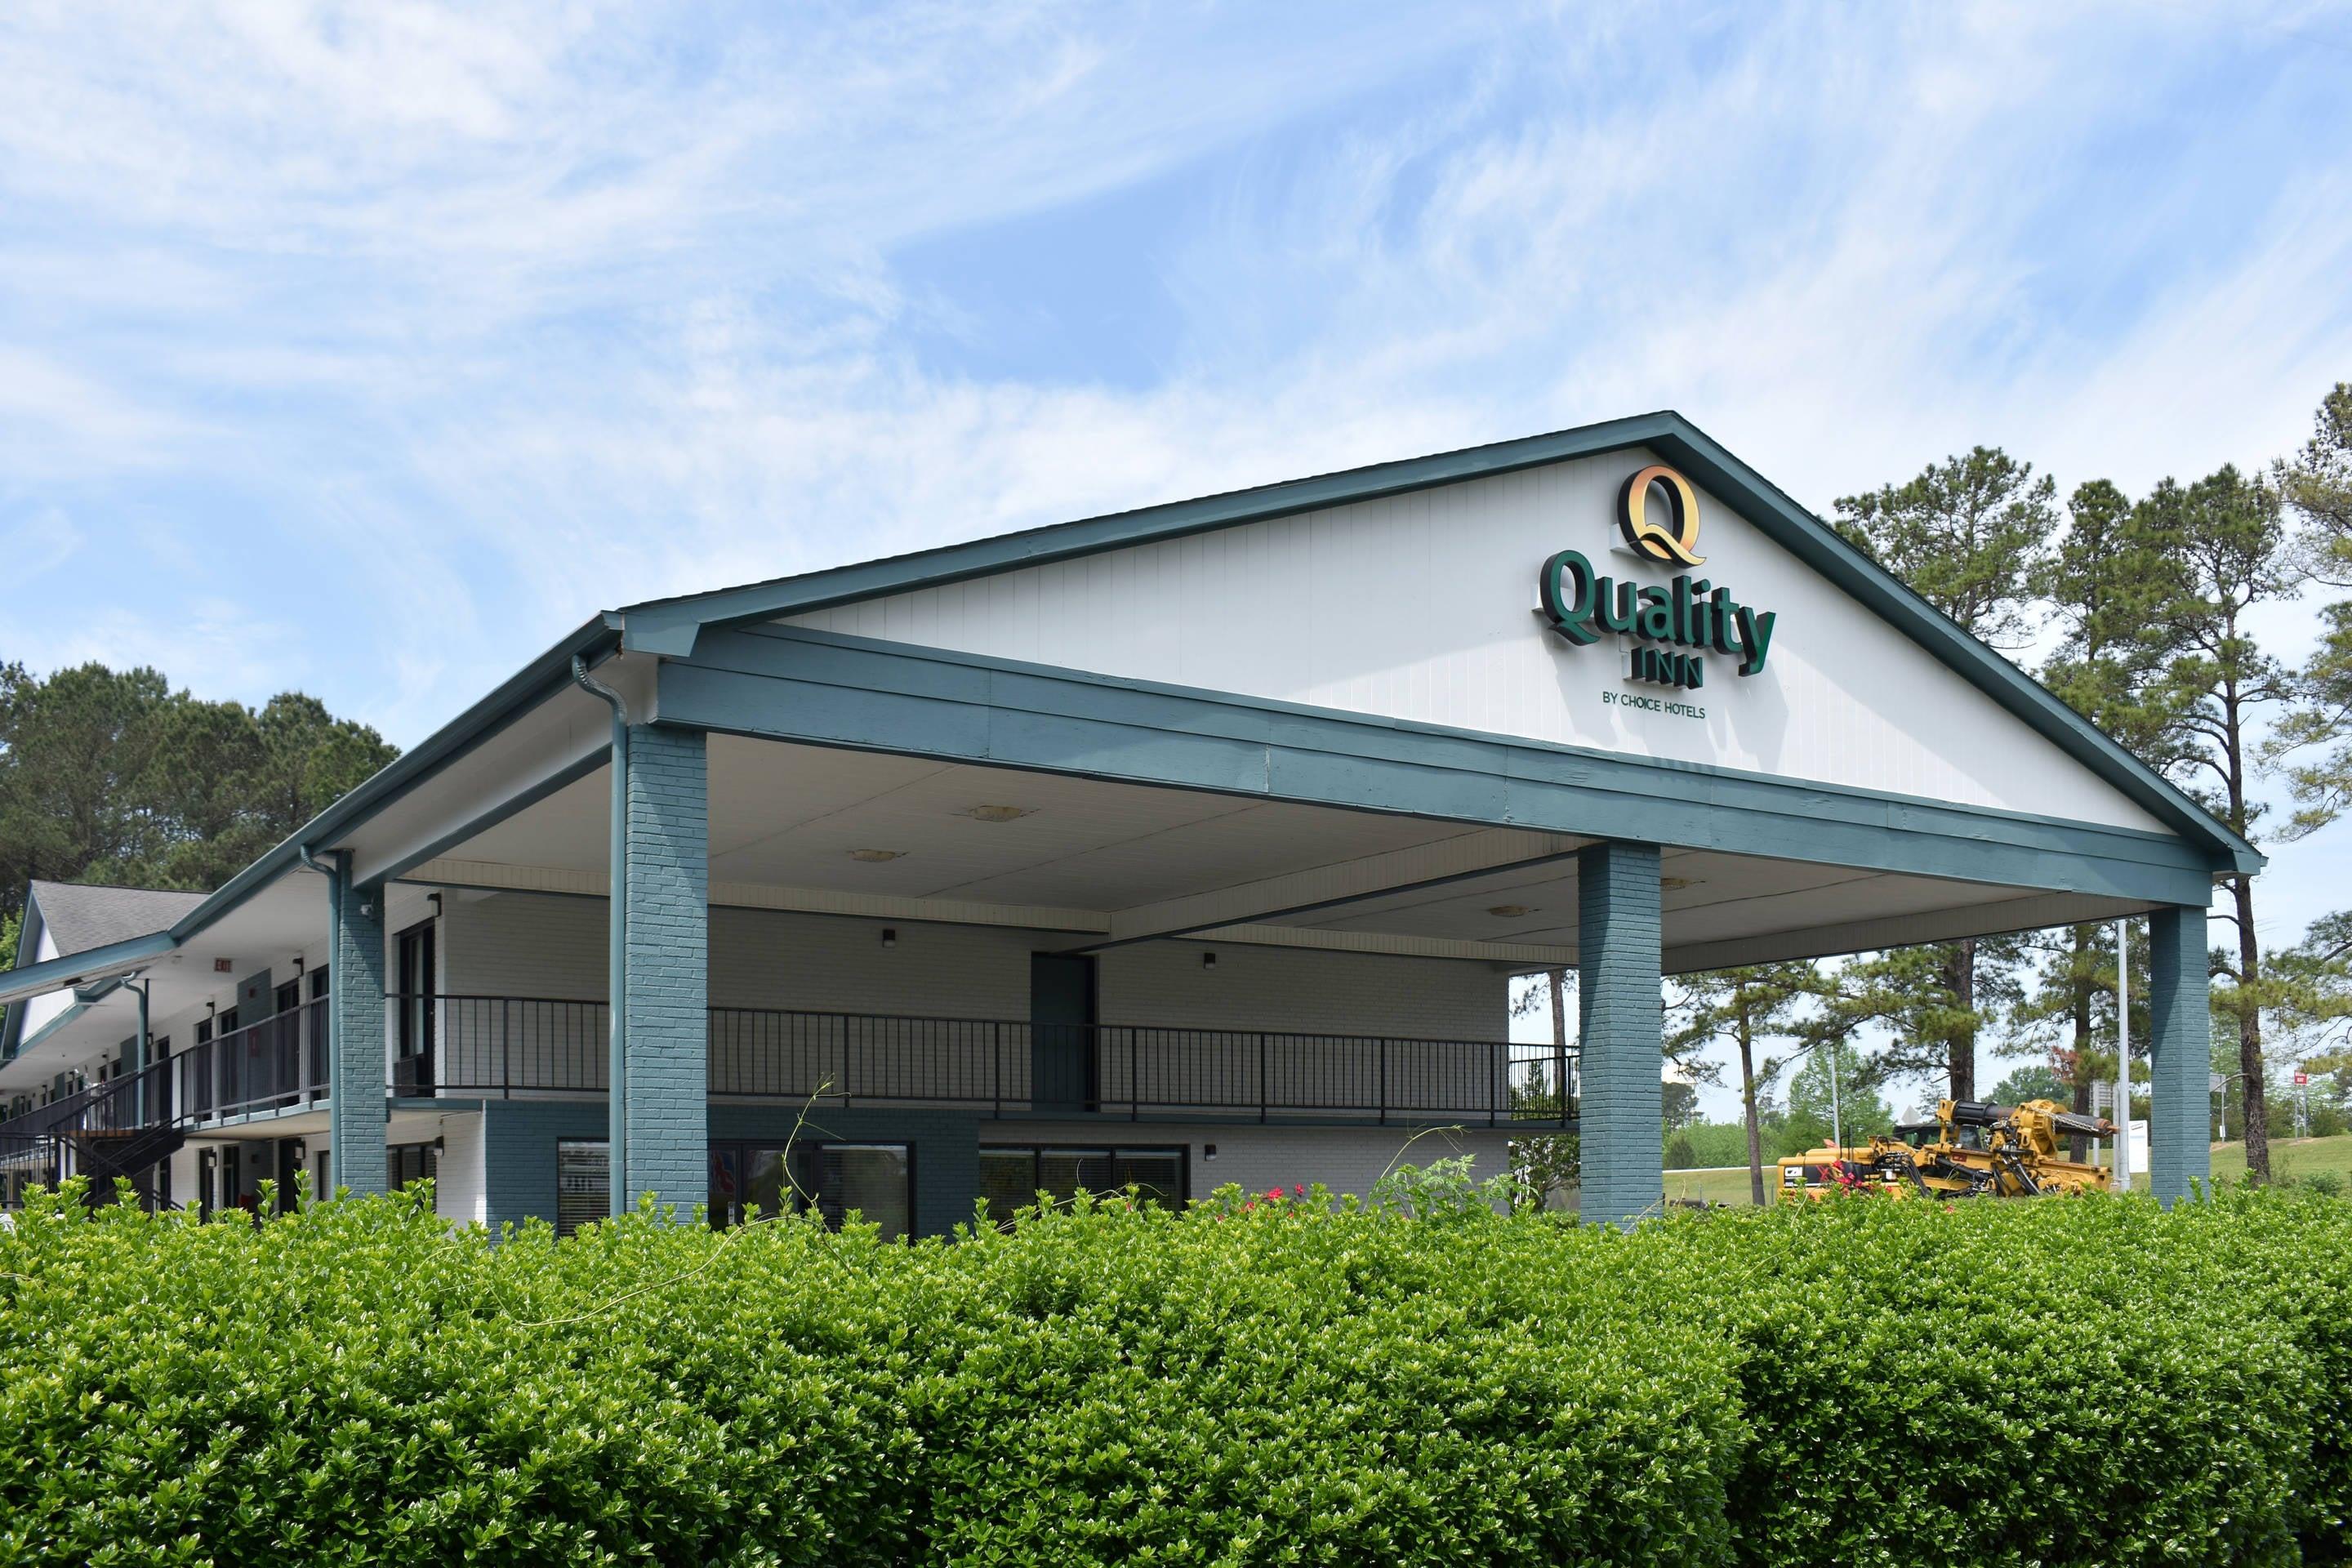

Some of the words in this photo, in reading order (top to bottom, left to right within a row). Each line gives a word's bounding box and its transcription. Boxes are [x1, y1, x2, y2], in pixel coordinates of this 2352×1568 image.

[1618, 465, 1707, 568] Q
[1540, 550, 1776, 677] Quality
[1632, 645, 1704, 690] INN
[1602, 691, 1618, 704] BY
[1620, 694, 1661, 712] CHOICE
[1664, 702, 1706, 719] HOTELS
